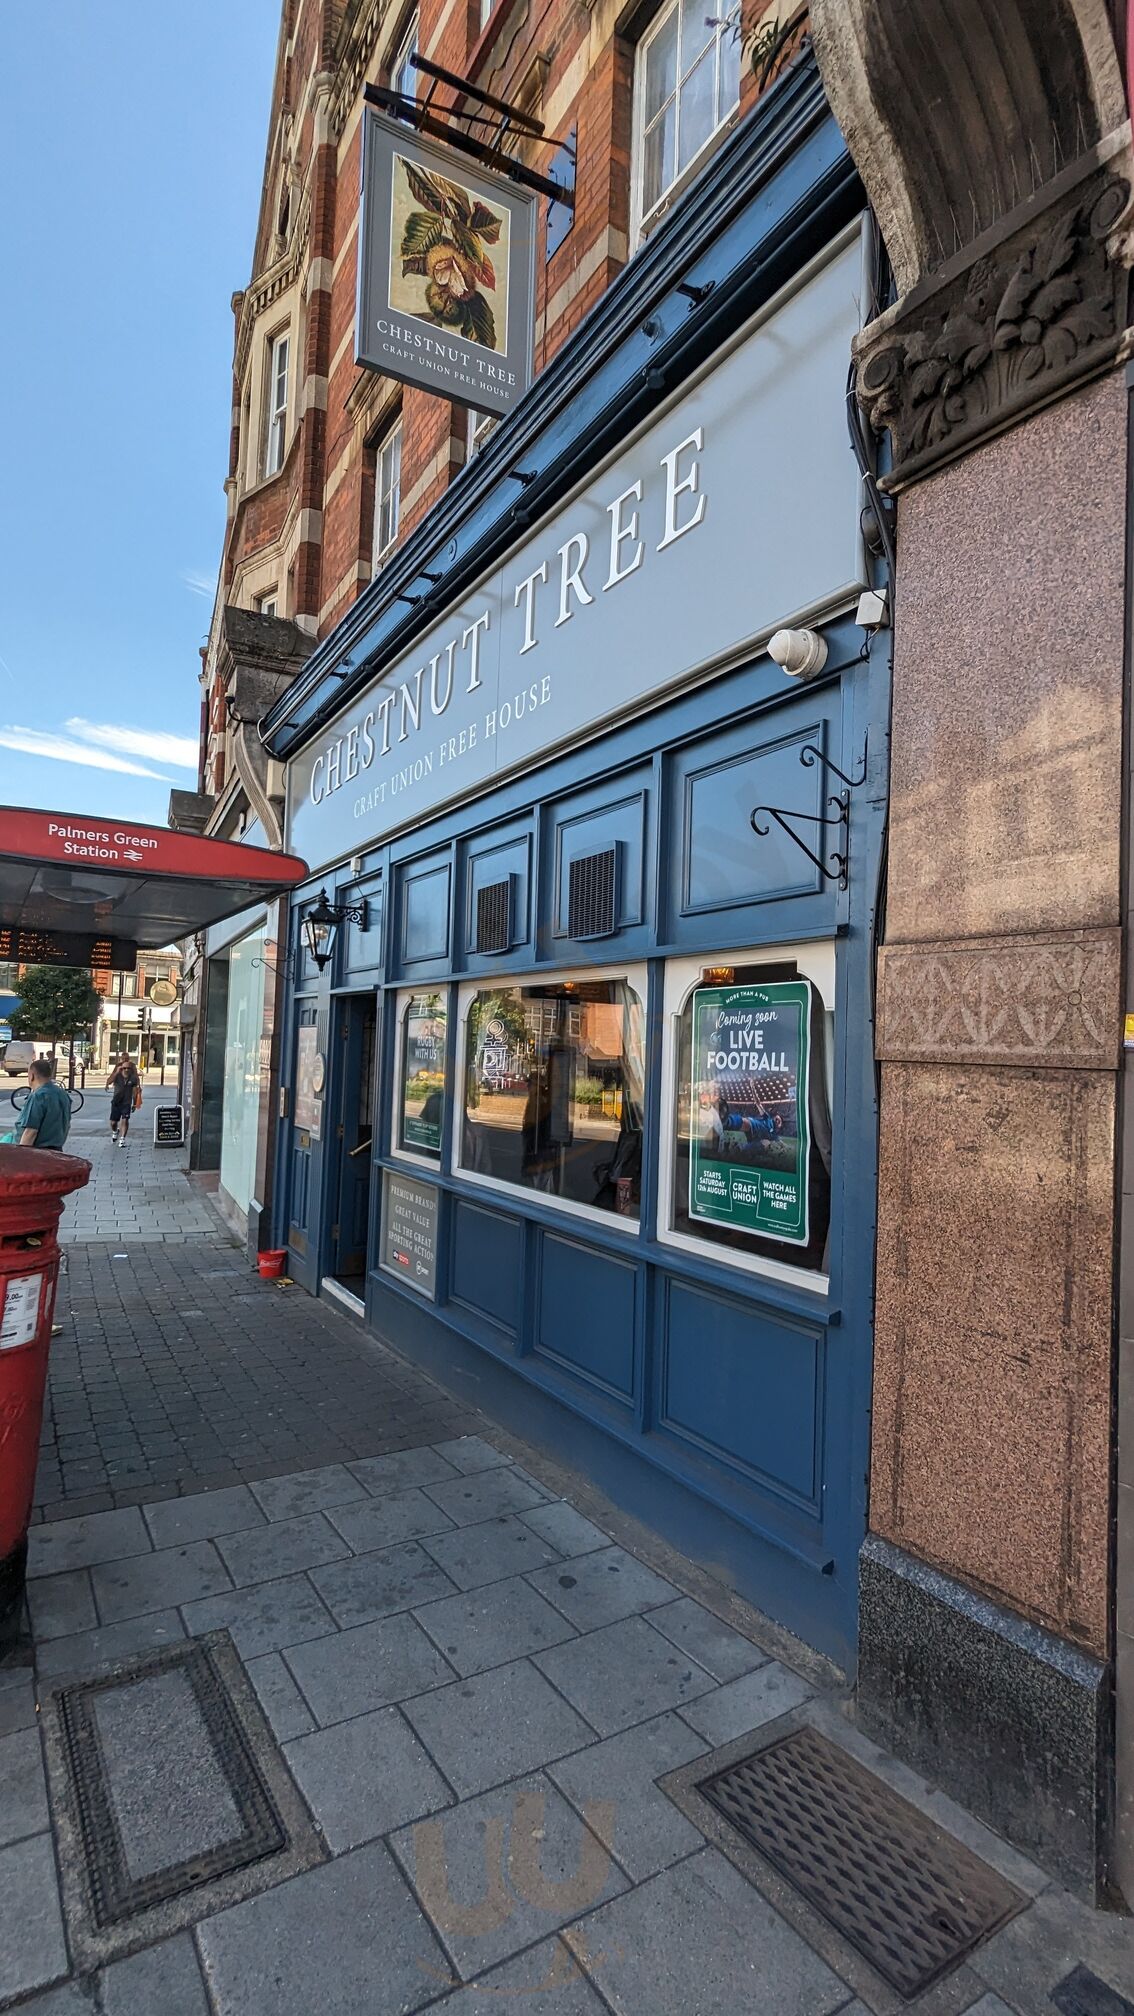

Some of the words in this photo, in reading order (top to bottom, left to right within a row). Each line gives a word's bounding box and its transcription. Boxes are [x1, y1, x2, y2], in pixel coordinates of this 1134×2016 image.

[377, 320, 470, 367] CHESTNUT
[476, 359, 516, 386] TREE
[382, 343, 415, 361] CRAFT
[418, 356, 451, 375] UNION
[454, 372, 477, 386] FREE
[479, 382, 510, 399] HOUSE
[310, 610, 491, 806] CHESTNUT
[514, 427, 707, 655] TREE
[353, 781, 388, 818] CRAFT
[390, 752, 434, 796] UNION
[439, 722, 478, 767] FREE
[484, 675, 552, 740] HOUSE
[48, 823, 109, 843] Palmers
[114, 832, 158, 849] Green
[64, 841, 118, 860] Station
[725, 992, 739, 1004] MORE
[759, 993, 769, 1002] PUB
[718, 1010, 752, 1032] Coming
[755, 1011, 778, 1026] soon
[417, 1035, 436, 1047] RUGBY
[729, 1030, 764, 1049] LIVE
[414, 1047, 428, 1059] WITH
[429, 1048, 437, 1060] US
[707, 1051, 789, 1072] FOOTBALL
[699, 1177, 726, 1188] SATURDAY
[703, 1170, 722, 1180] STARTS
[390, 1184, 414, 1202] PREMIUM
[697, 1184, 707, 1192] 12th
[706, 1186, 728, 1197] AUGUST
[732, 1182, 757, 1195] CRAFT
[732, 1190, 757, 1203] UNION
[763, 1181, 784, 1192] WATCH
[785, 1185, 796, 1194] ALL
[763, 1190, 775, 1198] THE
[775, 1192, 796, 1203] GAMES
[770, 1201, 787, 1210] HERE
[394, 1204, 412, 1219] GREAT
[412, 1211, 430, 1228] VALUE
[392, 1221, 401, 1233] ALL
[402, 1225, 413, 1239] THE
[413, 1231, 432, 1248] GREAT
